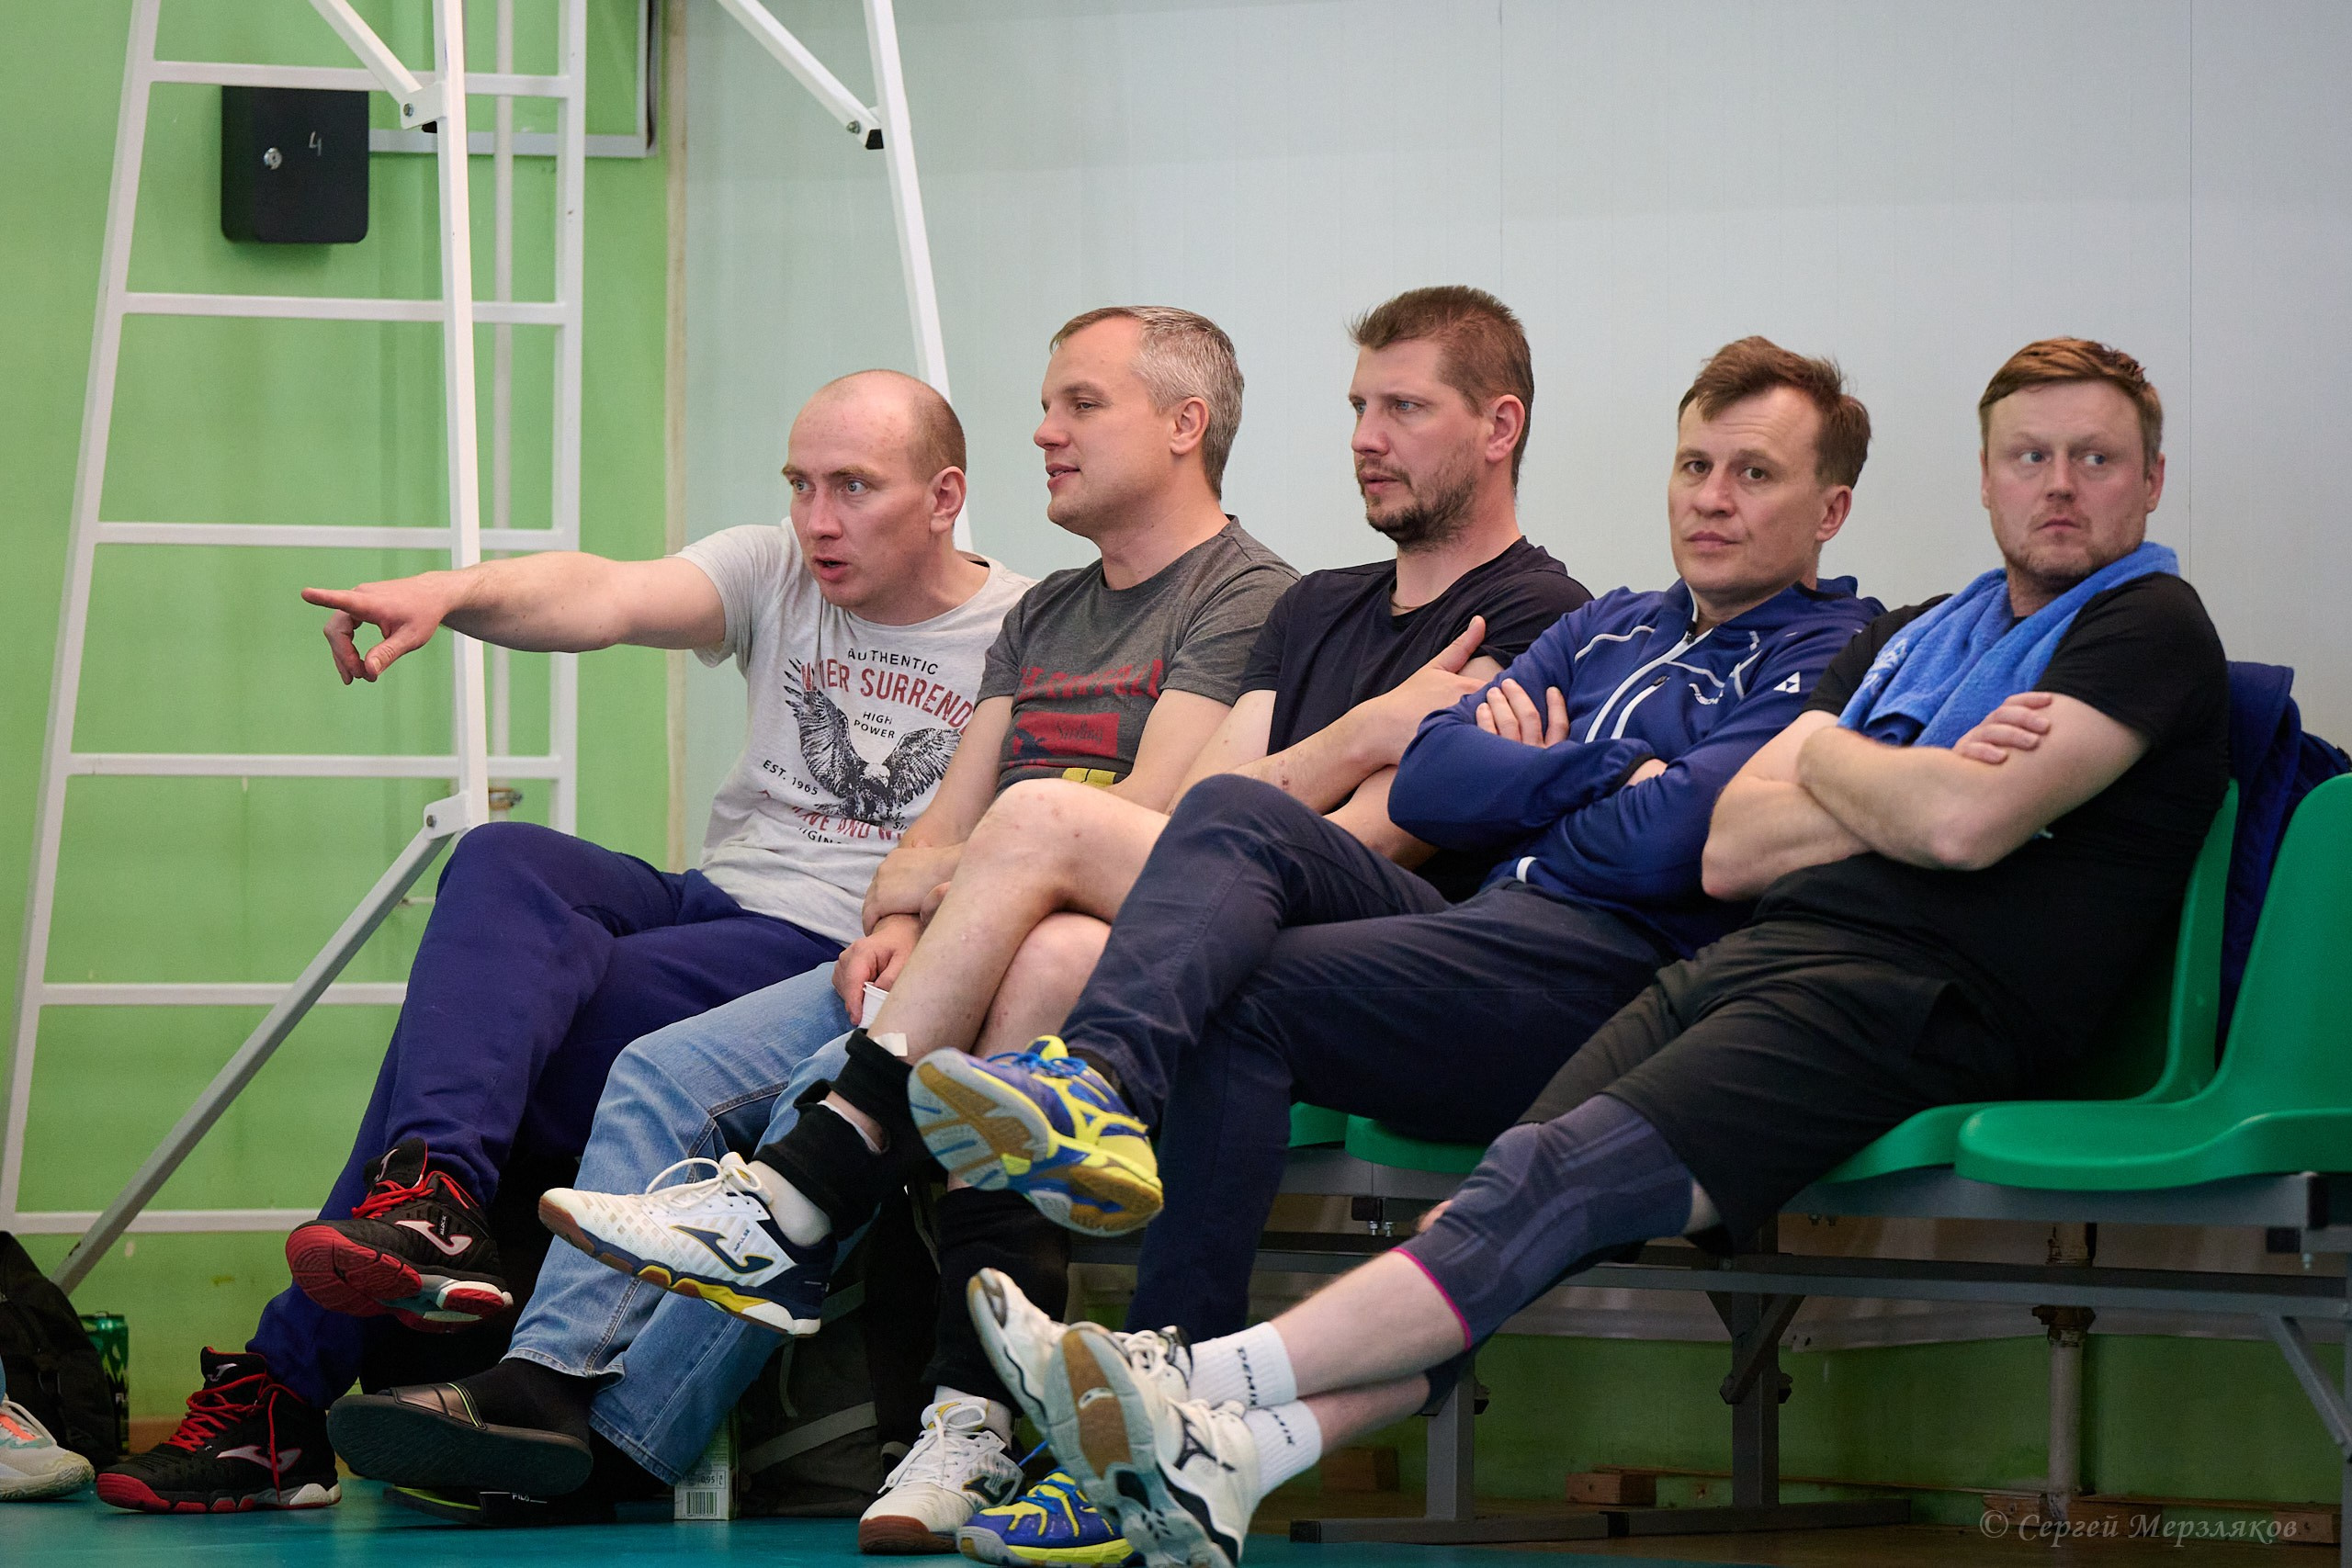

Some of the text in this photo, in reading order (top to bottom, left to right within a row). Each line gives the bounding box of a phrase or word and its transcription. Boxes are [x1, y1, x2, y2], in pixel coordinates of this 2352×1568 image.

[309, 131, 322, 157] 4
[847, 648, 939, 675] AUTHENTIC
[800, 658, 973, 733] NER SURREND
[854, 719, 896, 739] POWER
[862, 711, 893, 726] HIGH
[763, 759, 786, 780] EST.
[792, 777, 819, 796] 1965
